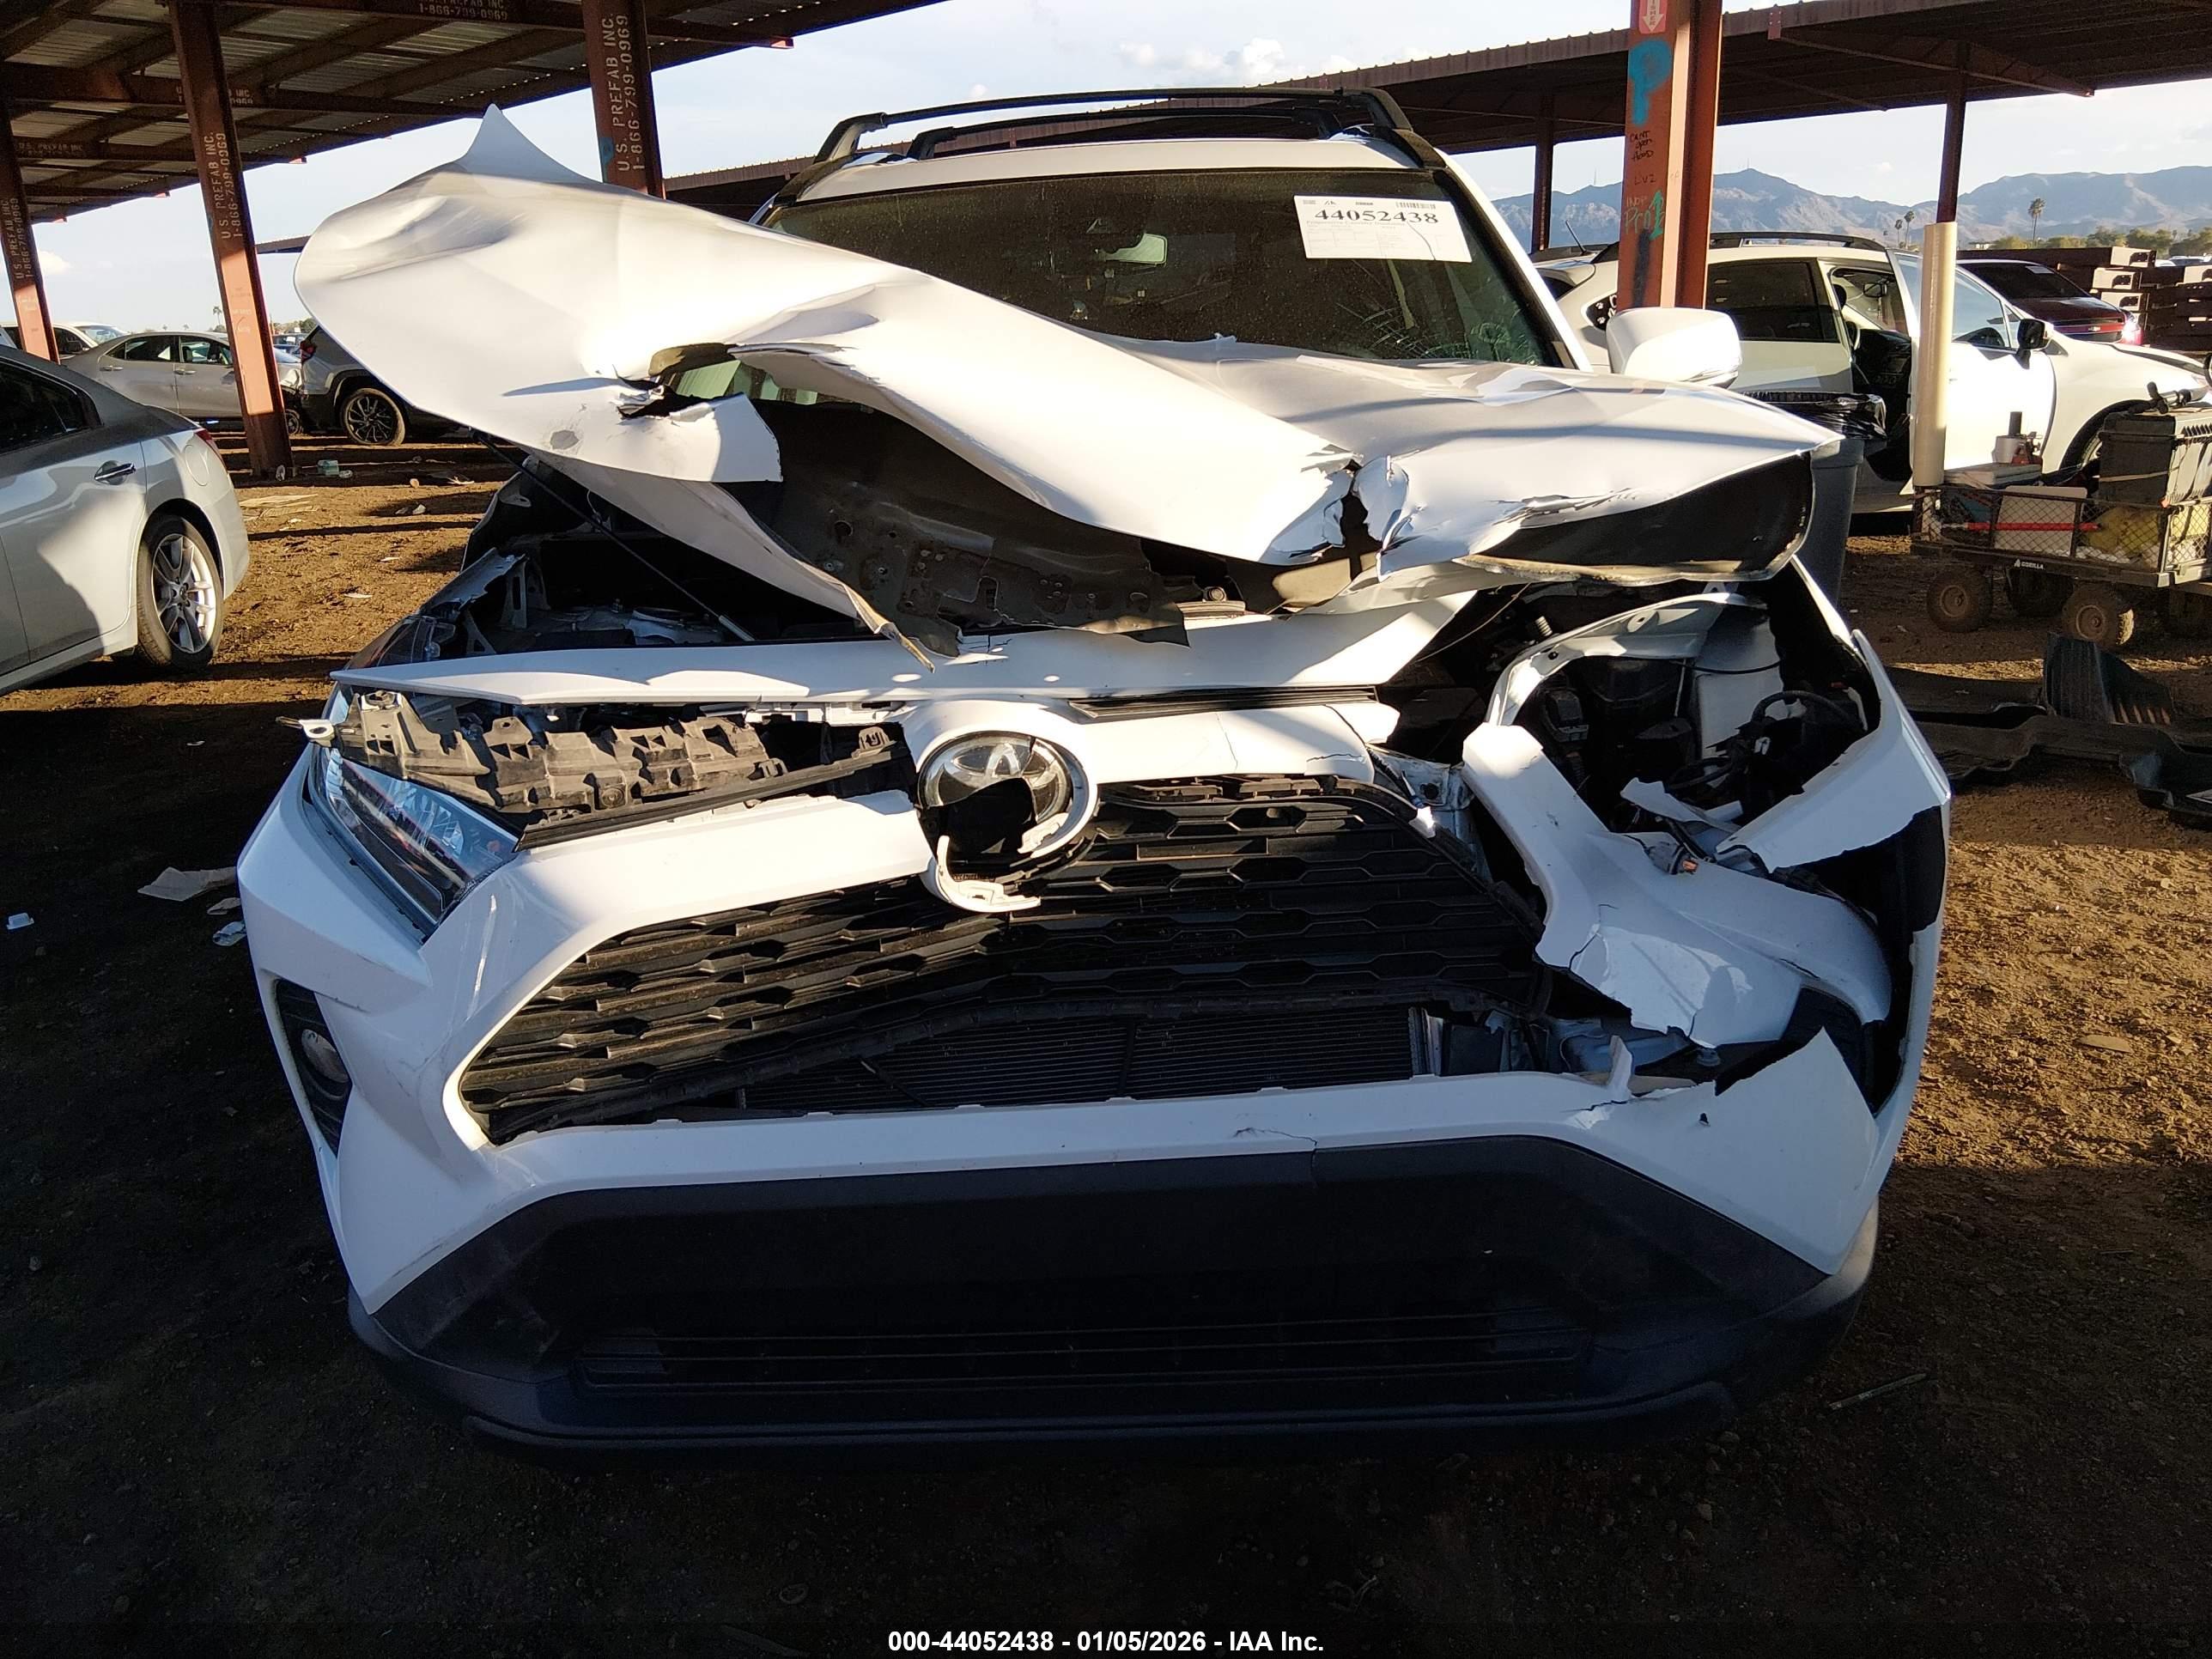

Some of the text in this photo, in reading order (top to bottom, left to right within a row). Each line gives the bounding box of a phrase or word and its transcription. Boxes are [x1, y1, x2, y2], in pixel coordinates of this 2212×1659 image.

[602, 13, 616, 46] INC.
[606, 57, 627, 127] PREFAB
[616, 15, 646, 170] 1-866-799-0969
[204, 131, 216, 155] INC.
[208, 161, 227, 209] PREFAB
[216, 133, 244, 238] 1-866-799-0969
[1315, 209, 1438, 224] 44052438
